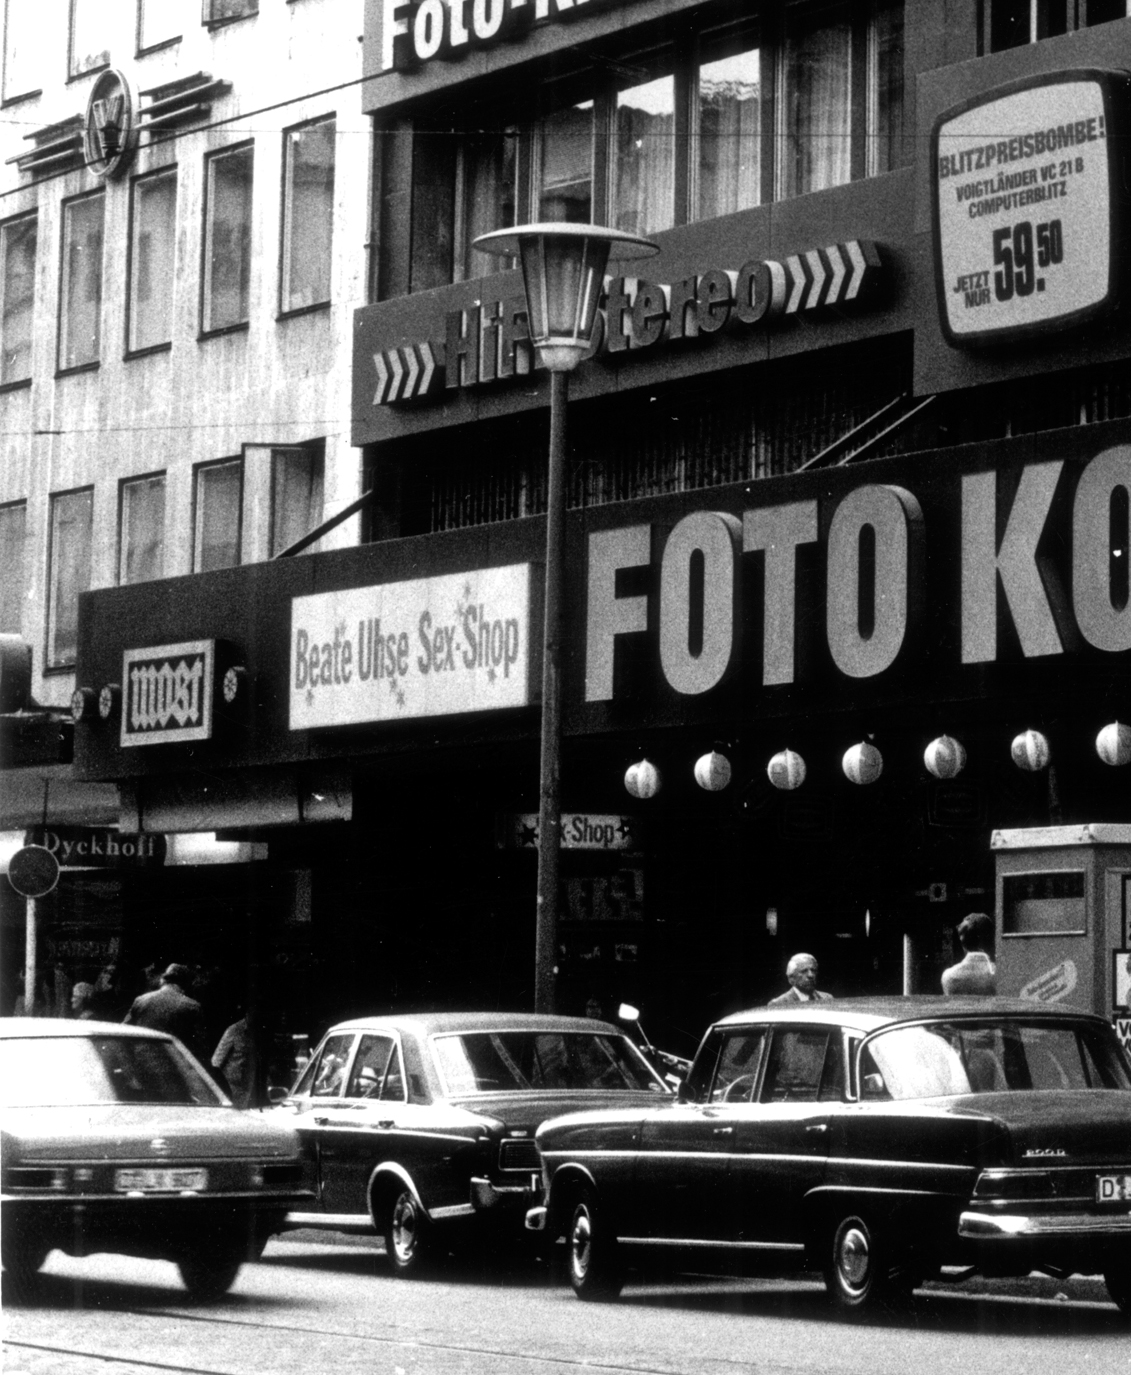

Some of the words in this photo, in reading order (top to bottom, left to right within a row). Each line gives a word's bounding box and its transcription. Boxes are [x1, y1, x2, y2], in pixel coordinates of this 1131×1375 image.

[938, 115, 1106, 179] BLITZPREISBOMBE!
[956, 168, 1039, 202] VOIGTLÄNDER
[1041, 163, 1057, 182] VC
[968, 180, 1068, 219] COMPUTERBLITZ
[952, 270, 990, 294] JETZT
[964, 288, 991, 308] NUR
[584, 483, 914, 703] FOTO
[295, 626, 353, 690] Beate
[358, 617, 410, 681] Uhse
[417, 604, 519, 679] Sex-Shop
[43, 830, 157, 859] Dyckhoff
